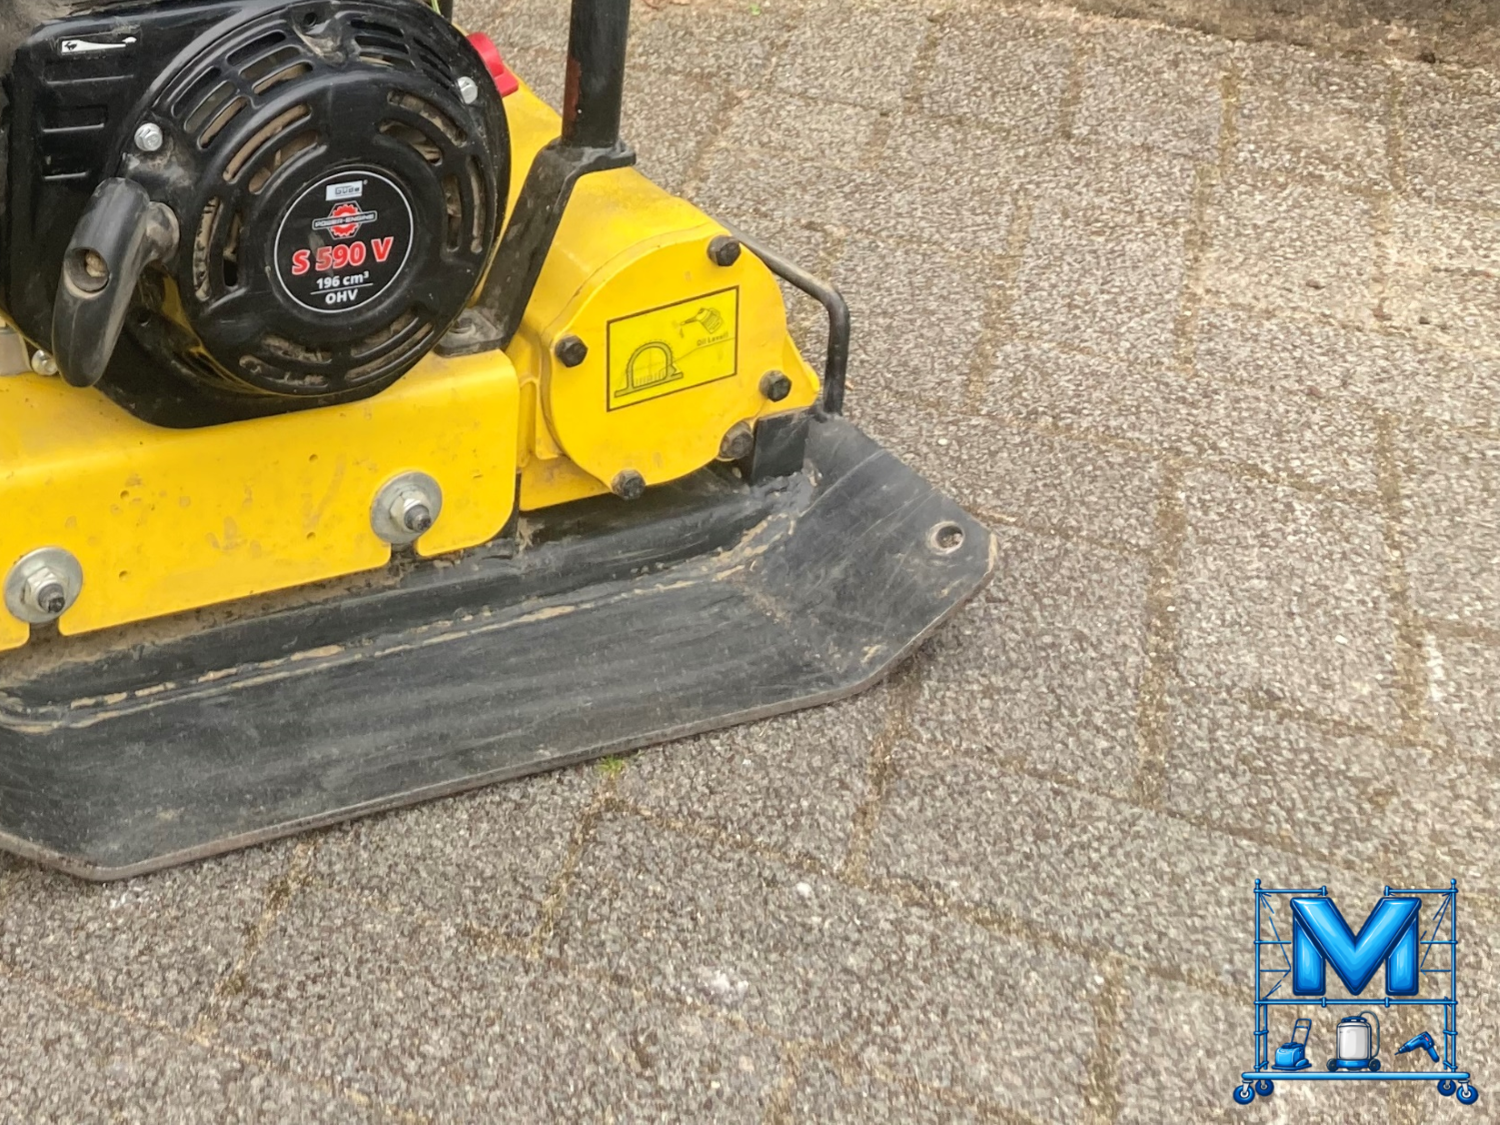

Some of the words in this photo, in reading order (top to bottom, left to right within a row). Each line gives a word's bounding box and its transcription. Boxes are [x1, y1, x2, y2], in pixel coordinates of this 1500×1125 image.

[291, 249, 311, 275] S
[315, 240, 367, 271] 590
[371, 236, 394, 262] V
[316, 276, 340, 290] 196
[325, 289, 359, 305] OHV
